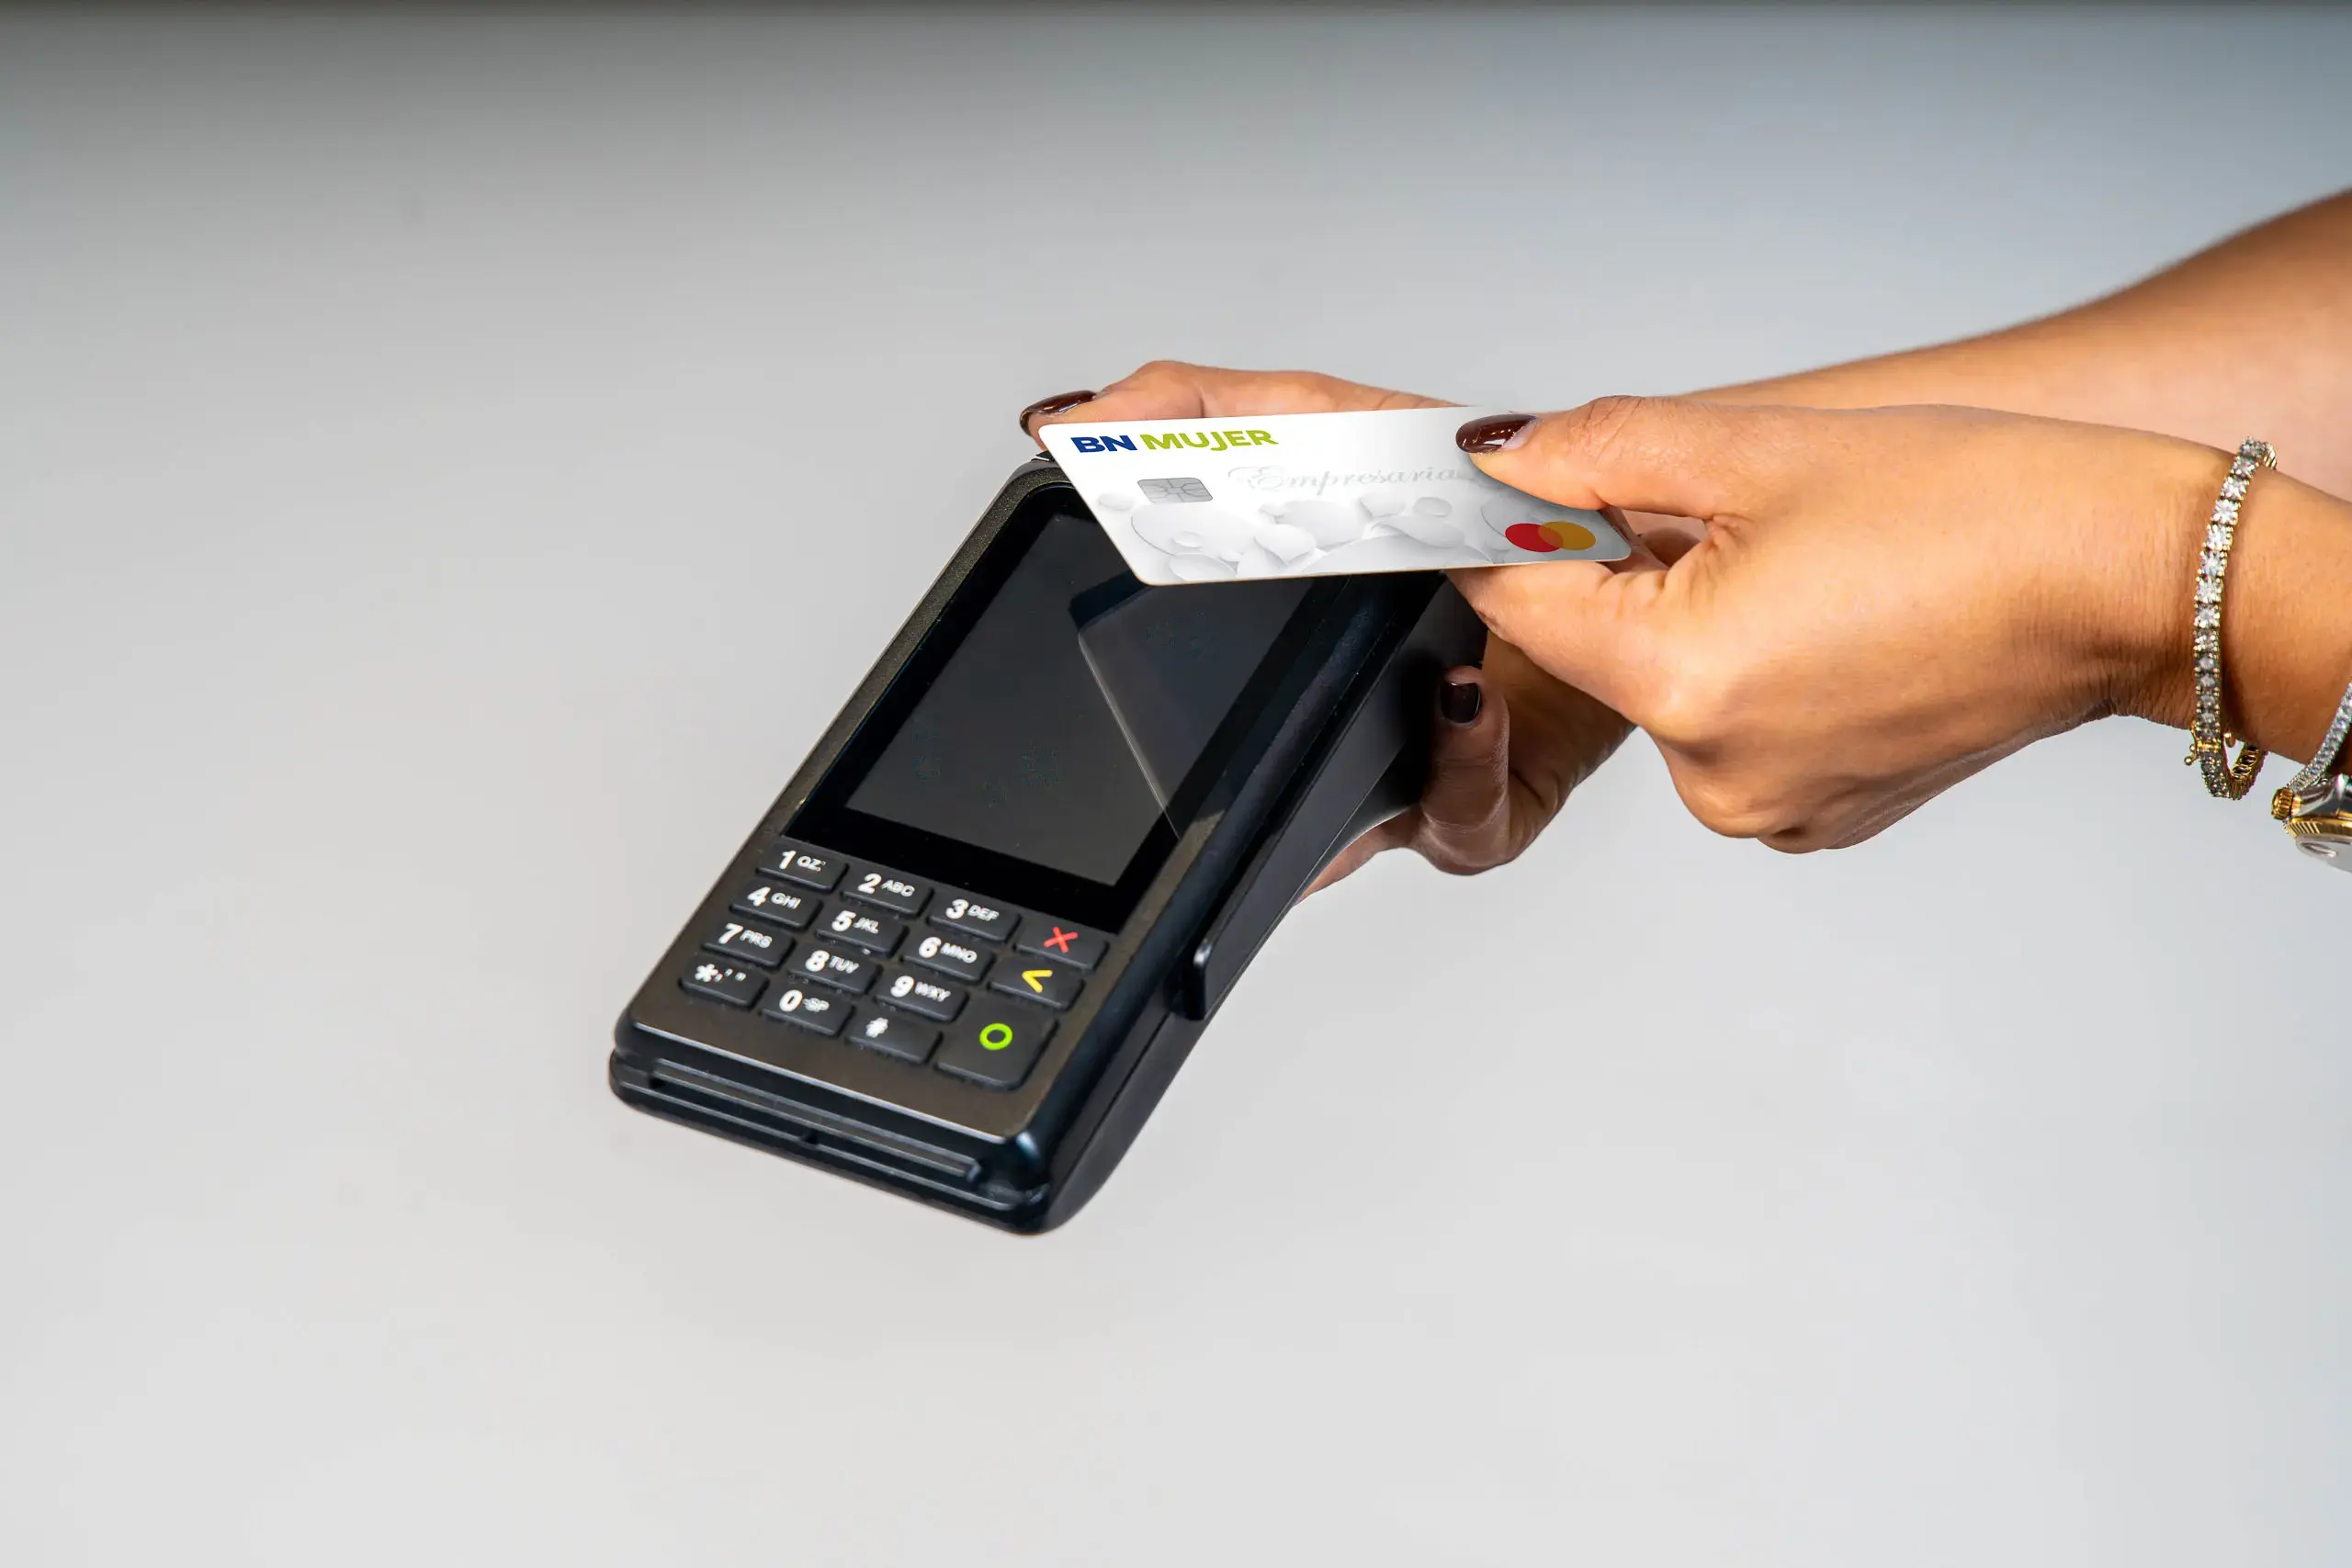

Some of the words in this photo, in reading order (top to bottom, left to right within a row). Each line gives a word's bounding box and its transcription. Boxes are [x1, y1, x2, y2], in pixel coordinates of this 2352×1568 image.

[1070, 435, 1137, 453] BN
[1139, 430, 1279, 451] MUJER
[779, 850, 797, 870] 1
[857, 874, 882, 894] 2
[881, 879, 915, 897] ABC
[747, 886, 772, 907] 4
[771, 892, 801, 909] GHI
[945, 899, 969, 919] 3
[967, 904, 1000, 921] DEF
[831, 910, 856, 932] 5
[854, 917, 879, 934] JKL
[718, 922, 744, 944] 7
[740, 930, 773, 949] PRS
[919, 936, 942, 958] 6
[940, 942, 978, 964] MNO
[805, 950, 831, 972] 8
[829, 955, 860, 974] TUV
[890, 976, 915, 998] 9
[779, 989, 803, 1012] 0
